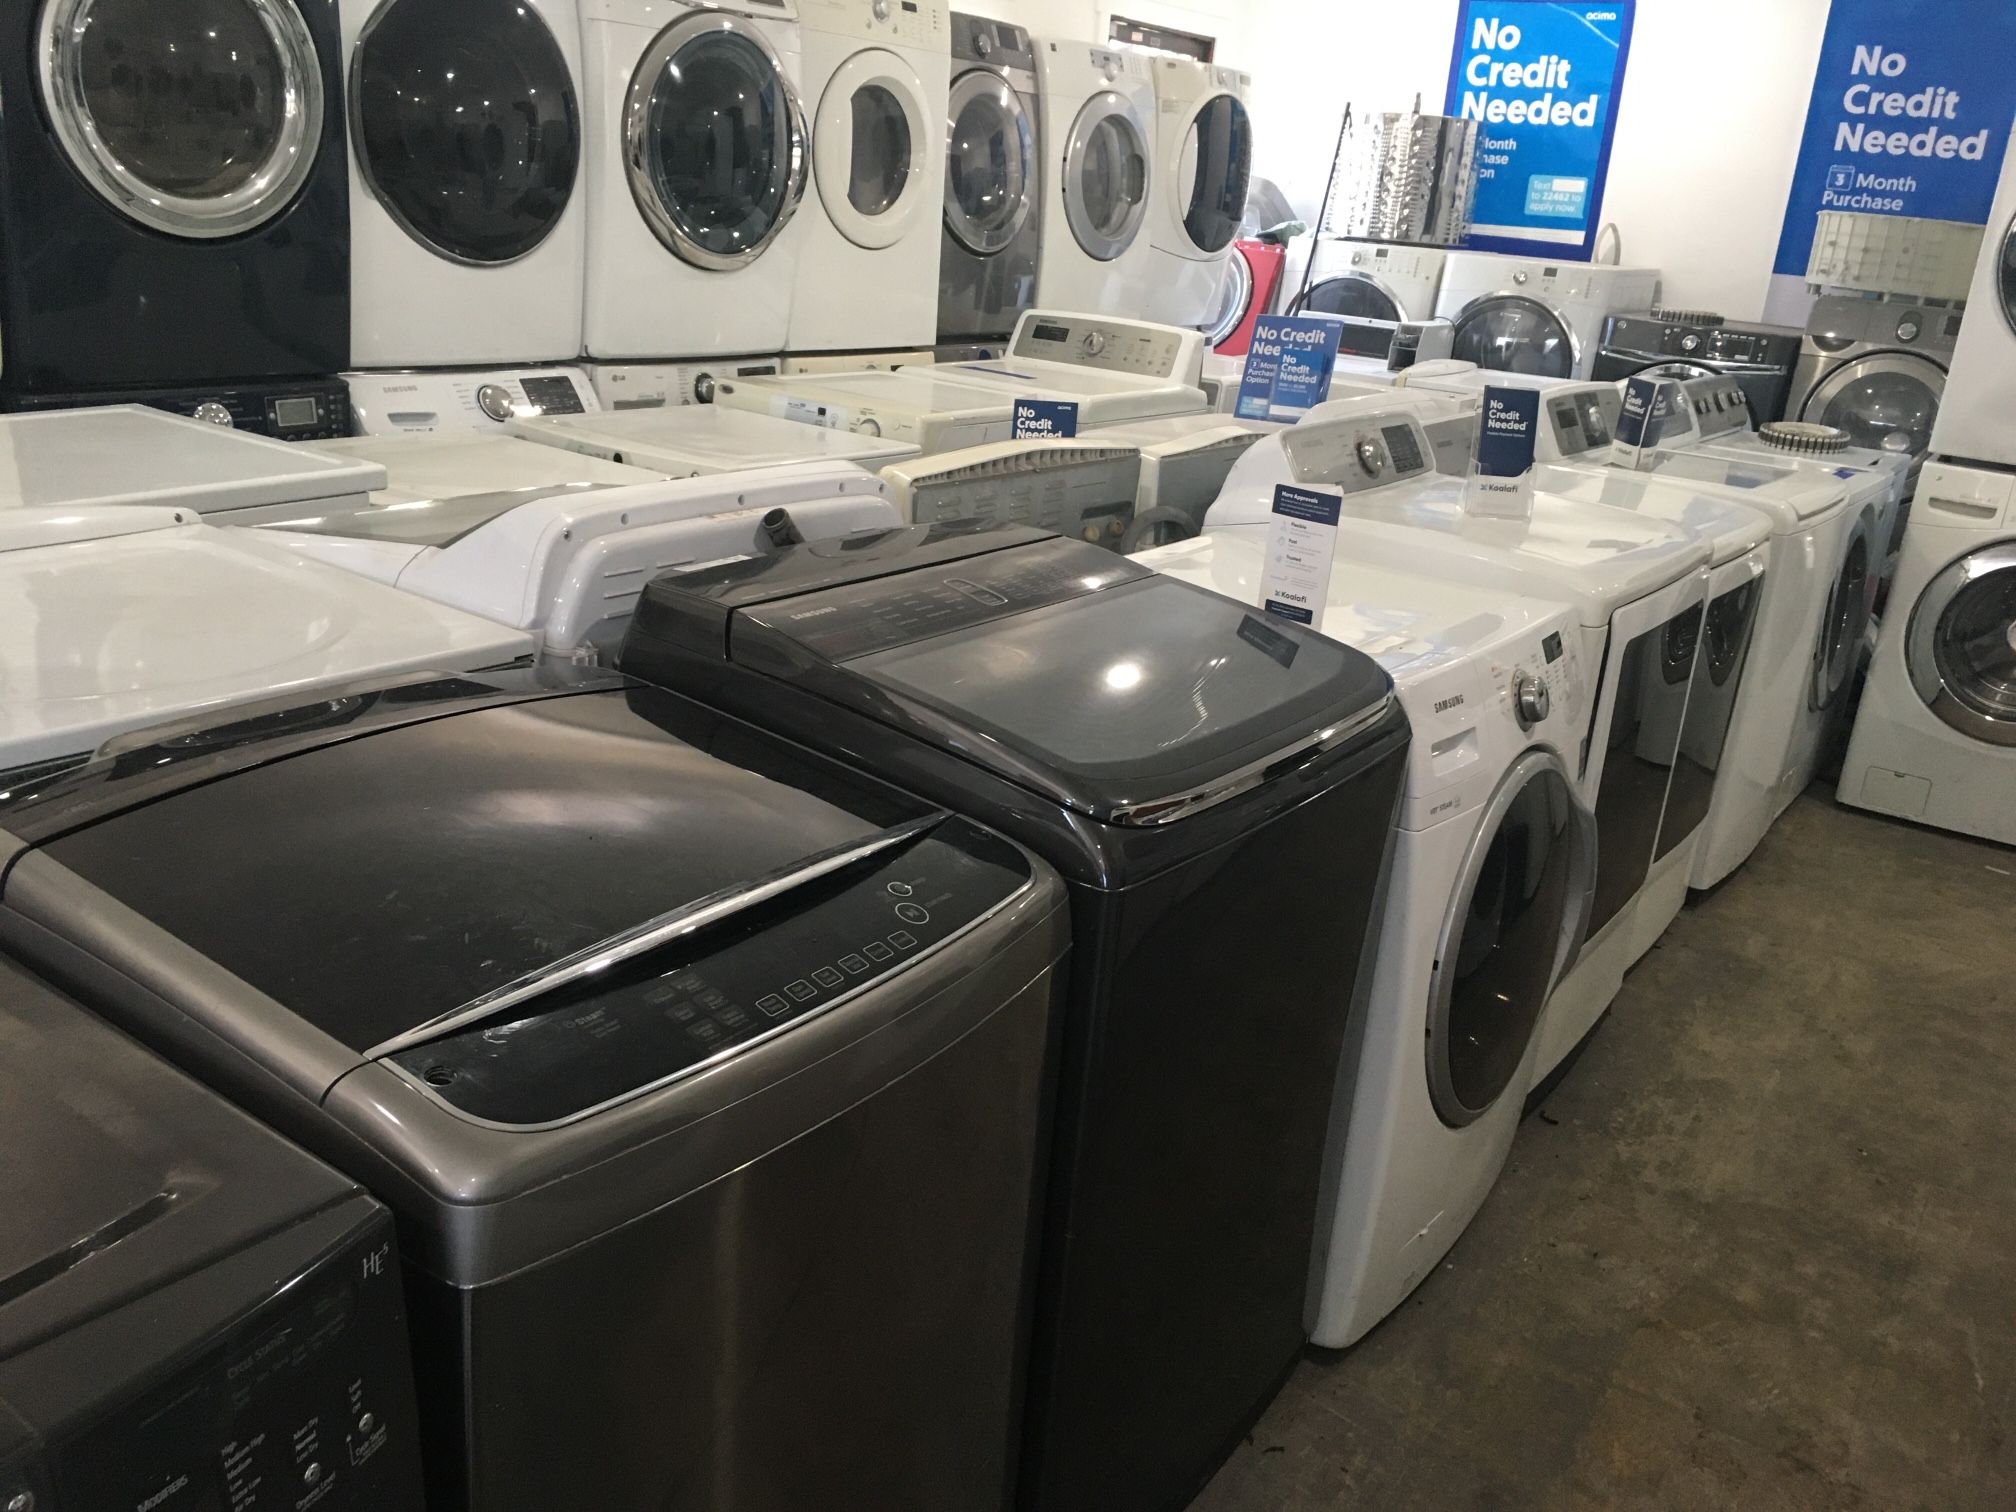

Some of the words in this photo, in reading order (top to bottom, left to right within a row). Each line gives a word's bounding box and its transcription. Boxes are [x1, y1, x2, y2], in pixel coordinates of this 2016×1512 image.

[1471, 17, 1521, 50] No
[1850, 44, 1907, 77] No
[1466, 54, 1571, 89] Credit
[1461, 91, 1599, 127] Needed
[1843, 83, 1960, 120] Credit
[1834, 121, 1989, 161] Needed
[1834, 172, 1845, 186] 3
[1856, 172, 1917, 192] Month
[1821, 190, 1904, 211] Purchase
[1256, 326, 1277, 340] No
[1280, 327, 1326, 345] Credit
[1282, 354, 1297, 364] No
[1281, 363, 1310, 374] Credit
[1280, 371, 1317, 384] Needed
[1018, 406, 1035, 418] No
[1489, 400, 1504, 409] No
[1488, 409, 1520, 421] Credit
[1017, 417, 1052, 430] Credit
[1016, 428, 1063, 439] Needed
[1488, 484, 1518, 493] Koalafi
[1281, 591, 1307, 603] Koalafi
[1434, 694, 1464, 713] SAMSUNG
